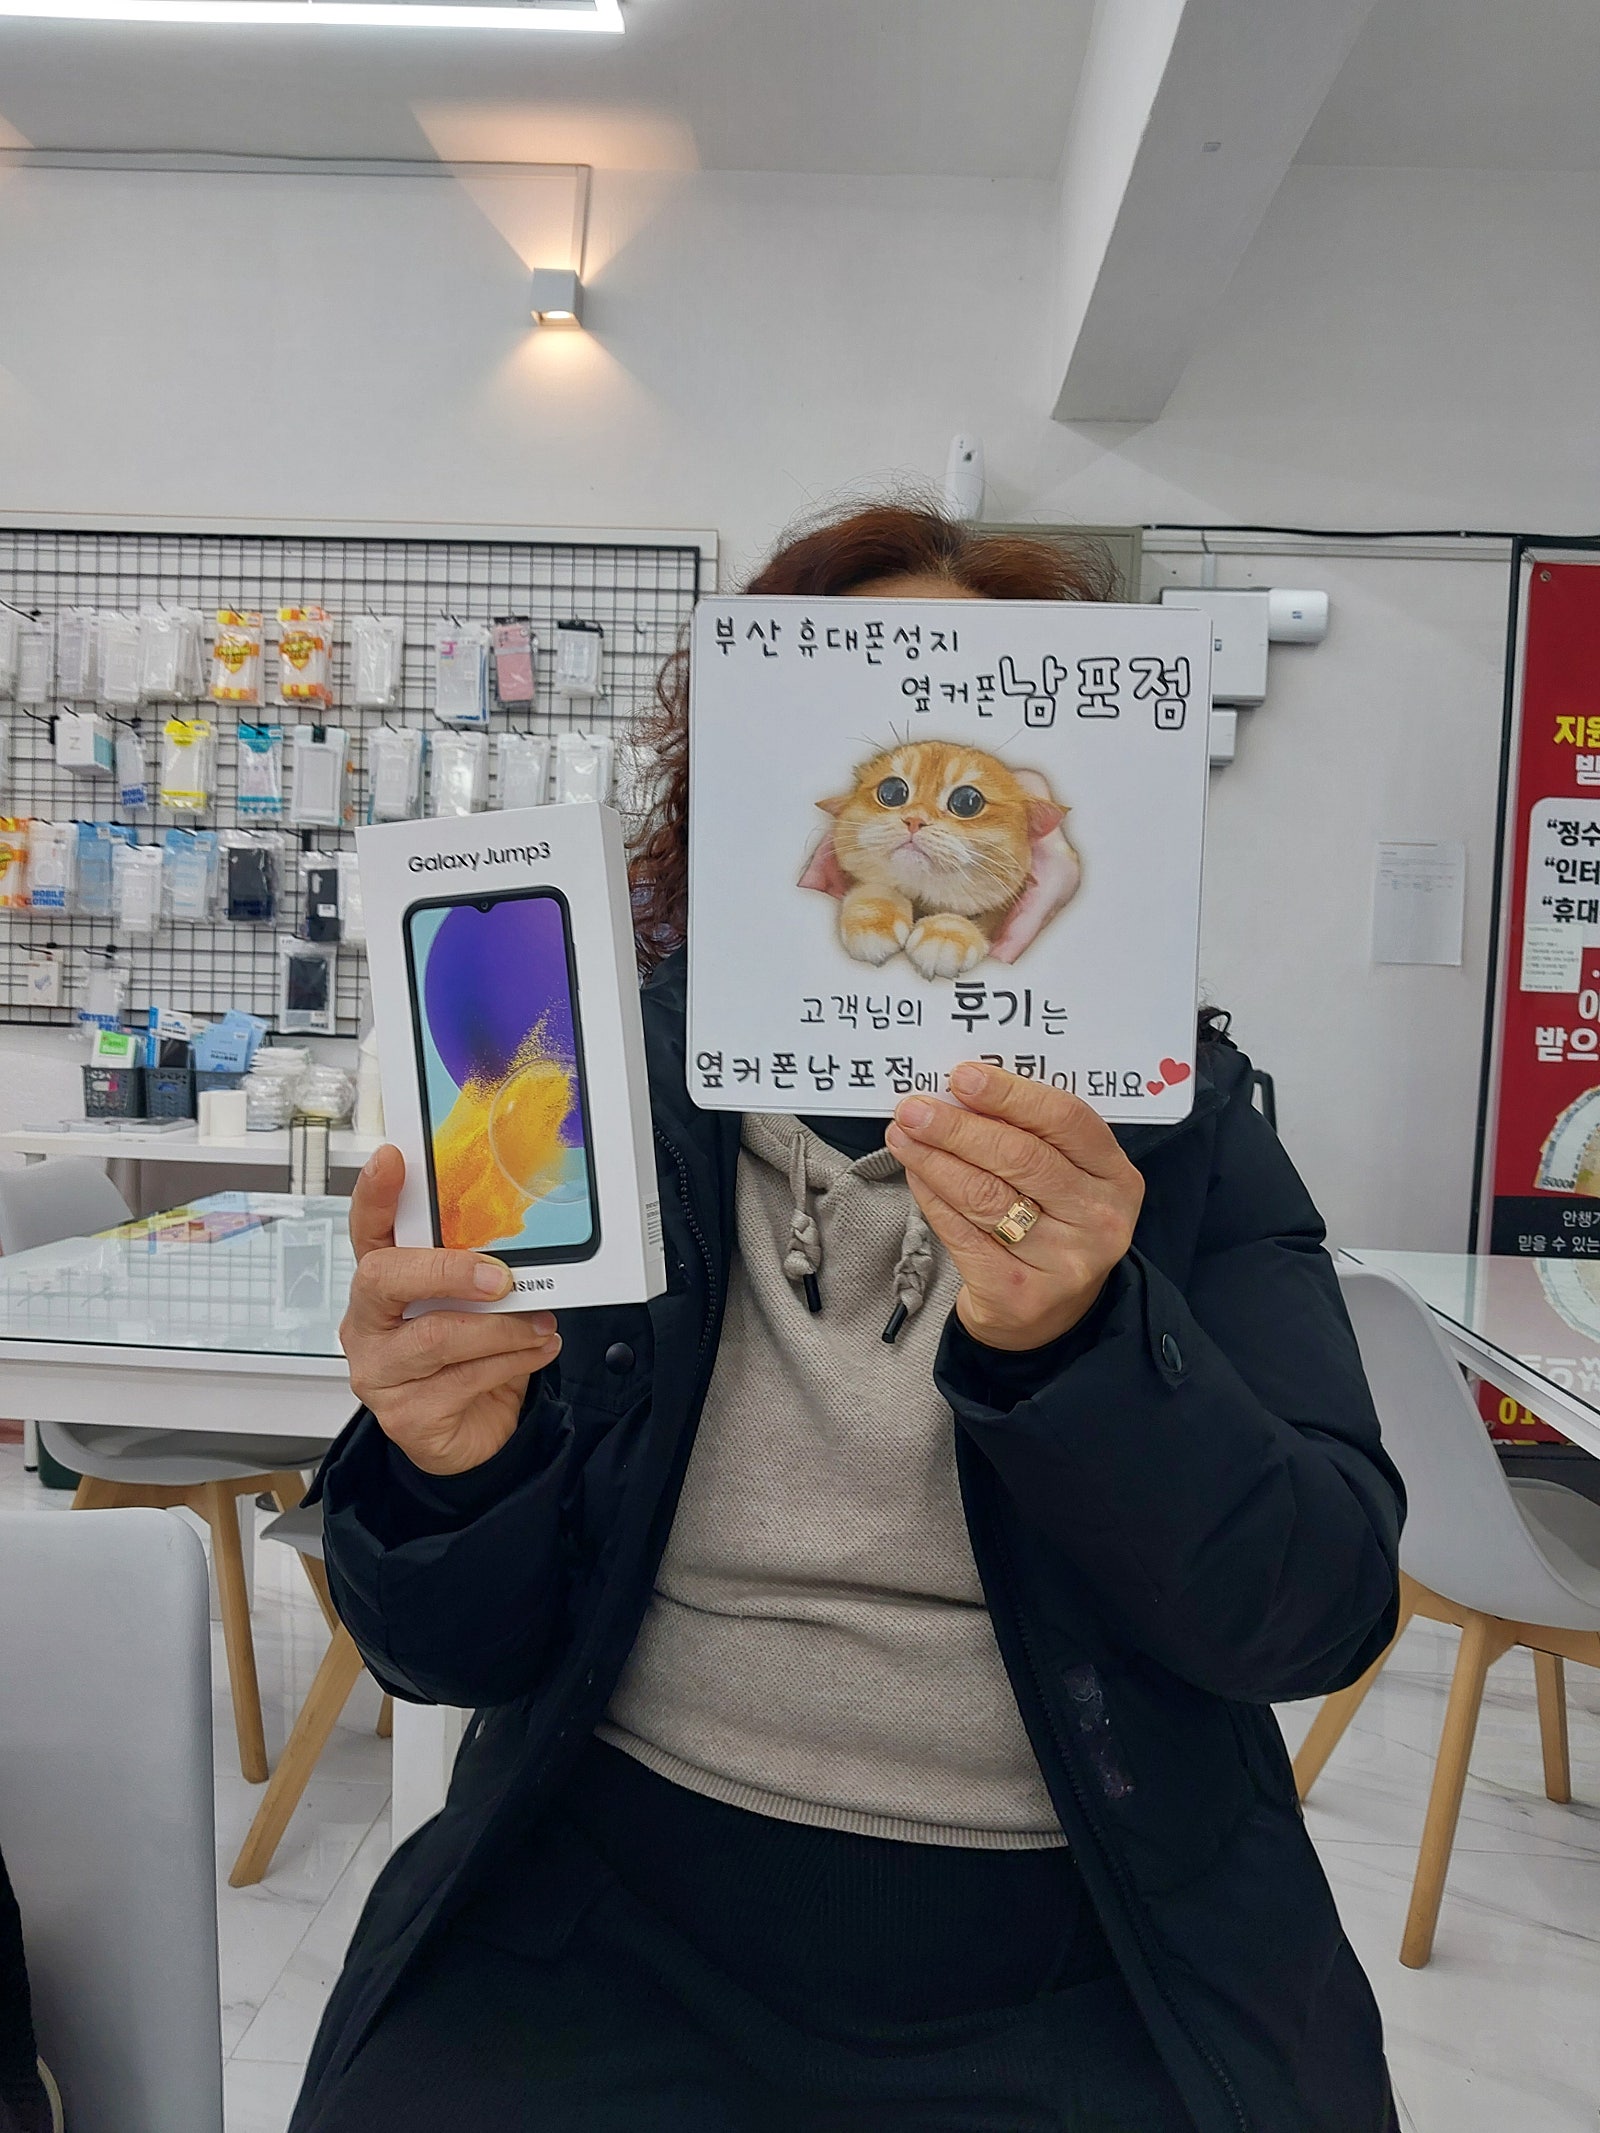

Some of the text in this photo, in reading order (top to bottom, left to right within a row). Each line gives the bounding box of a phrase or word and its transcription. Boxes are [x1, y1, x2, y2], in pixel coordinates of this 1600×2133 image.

[715, 616, 959, 665] 부산 휴대폰성지
[408, 841, 551, 873] Galaxy Jump3
[800, 981, 1068, 1035] 고객님의 후기는
[697, 1051, 951, 1094] 옆커폰남포점에
[1088, 1069, 1145, 1097] 돼요
[1518, 1234, 1548, 1252] 믿을
[1551, 1235, 1567, 1253] 수
[512, 1277, 556, 1293] SUNG
